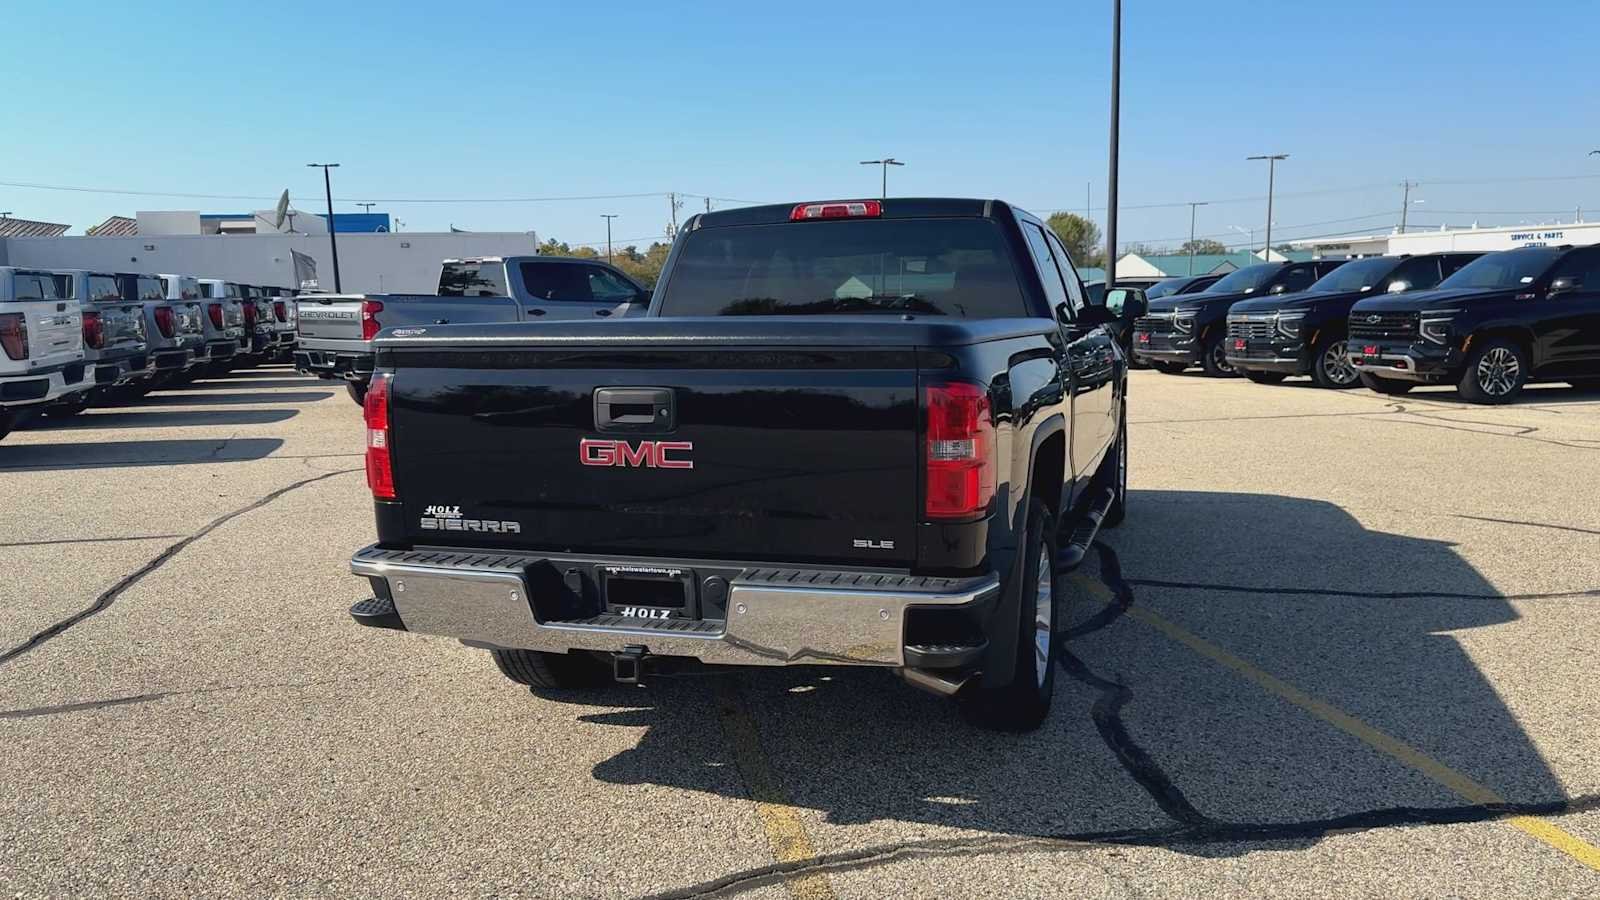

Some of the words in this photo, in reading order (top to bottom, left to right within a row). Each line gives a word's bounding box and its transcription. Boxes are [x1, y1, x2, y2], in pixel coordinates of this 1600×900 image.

[299, 311, 355, 320] CHEVROLET
[580, 438, 694, 469] GMC
[424, 505, 463, 515] HOLZ
[420, 517, 521, 534] SIERRA
[853, 539, 895, 549] SLE
[621, 607, 671, 620] HOLZ
